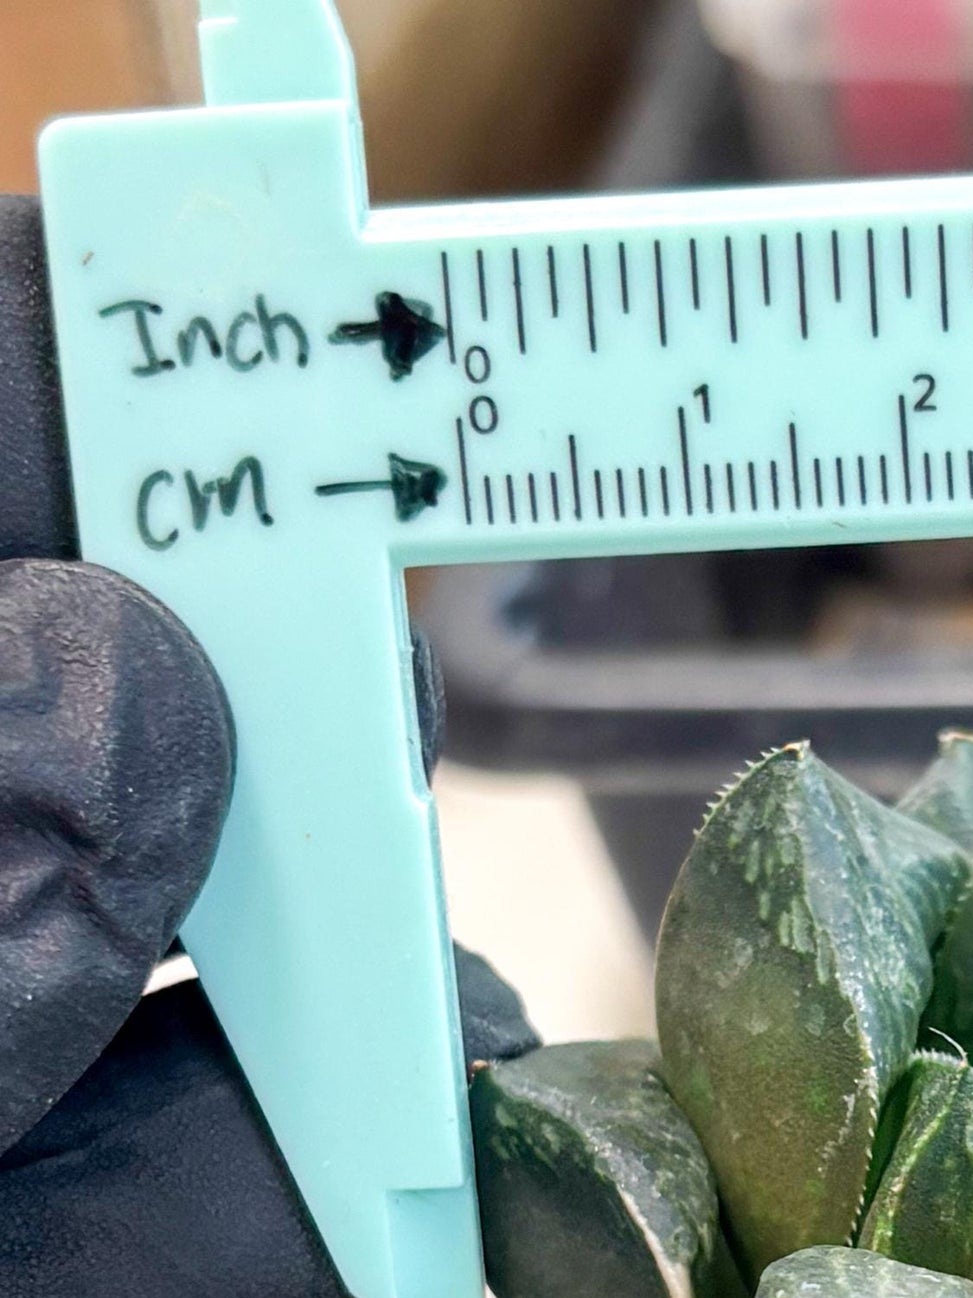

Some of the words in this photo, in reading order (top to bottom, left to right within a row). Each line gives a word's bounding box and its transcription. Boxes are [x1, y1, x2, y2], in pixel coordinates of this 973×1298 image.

[96, 292, 313, 379] Inch
[462, 343, 493, 386] 0
[467, 393, 501, 437] 0
[691, 381, 713, 426] 1
[910, 370, 940, 415] 2
